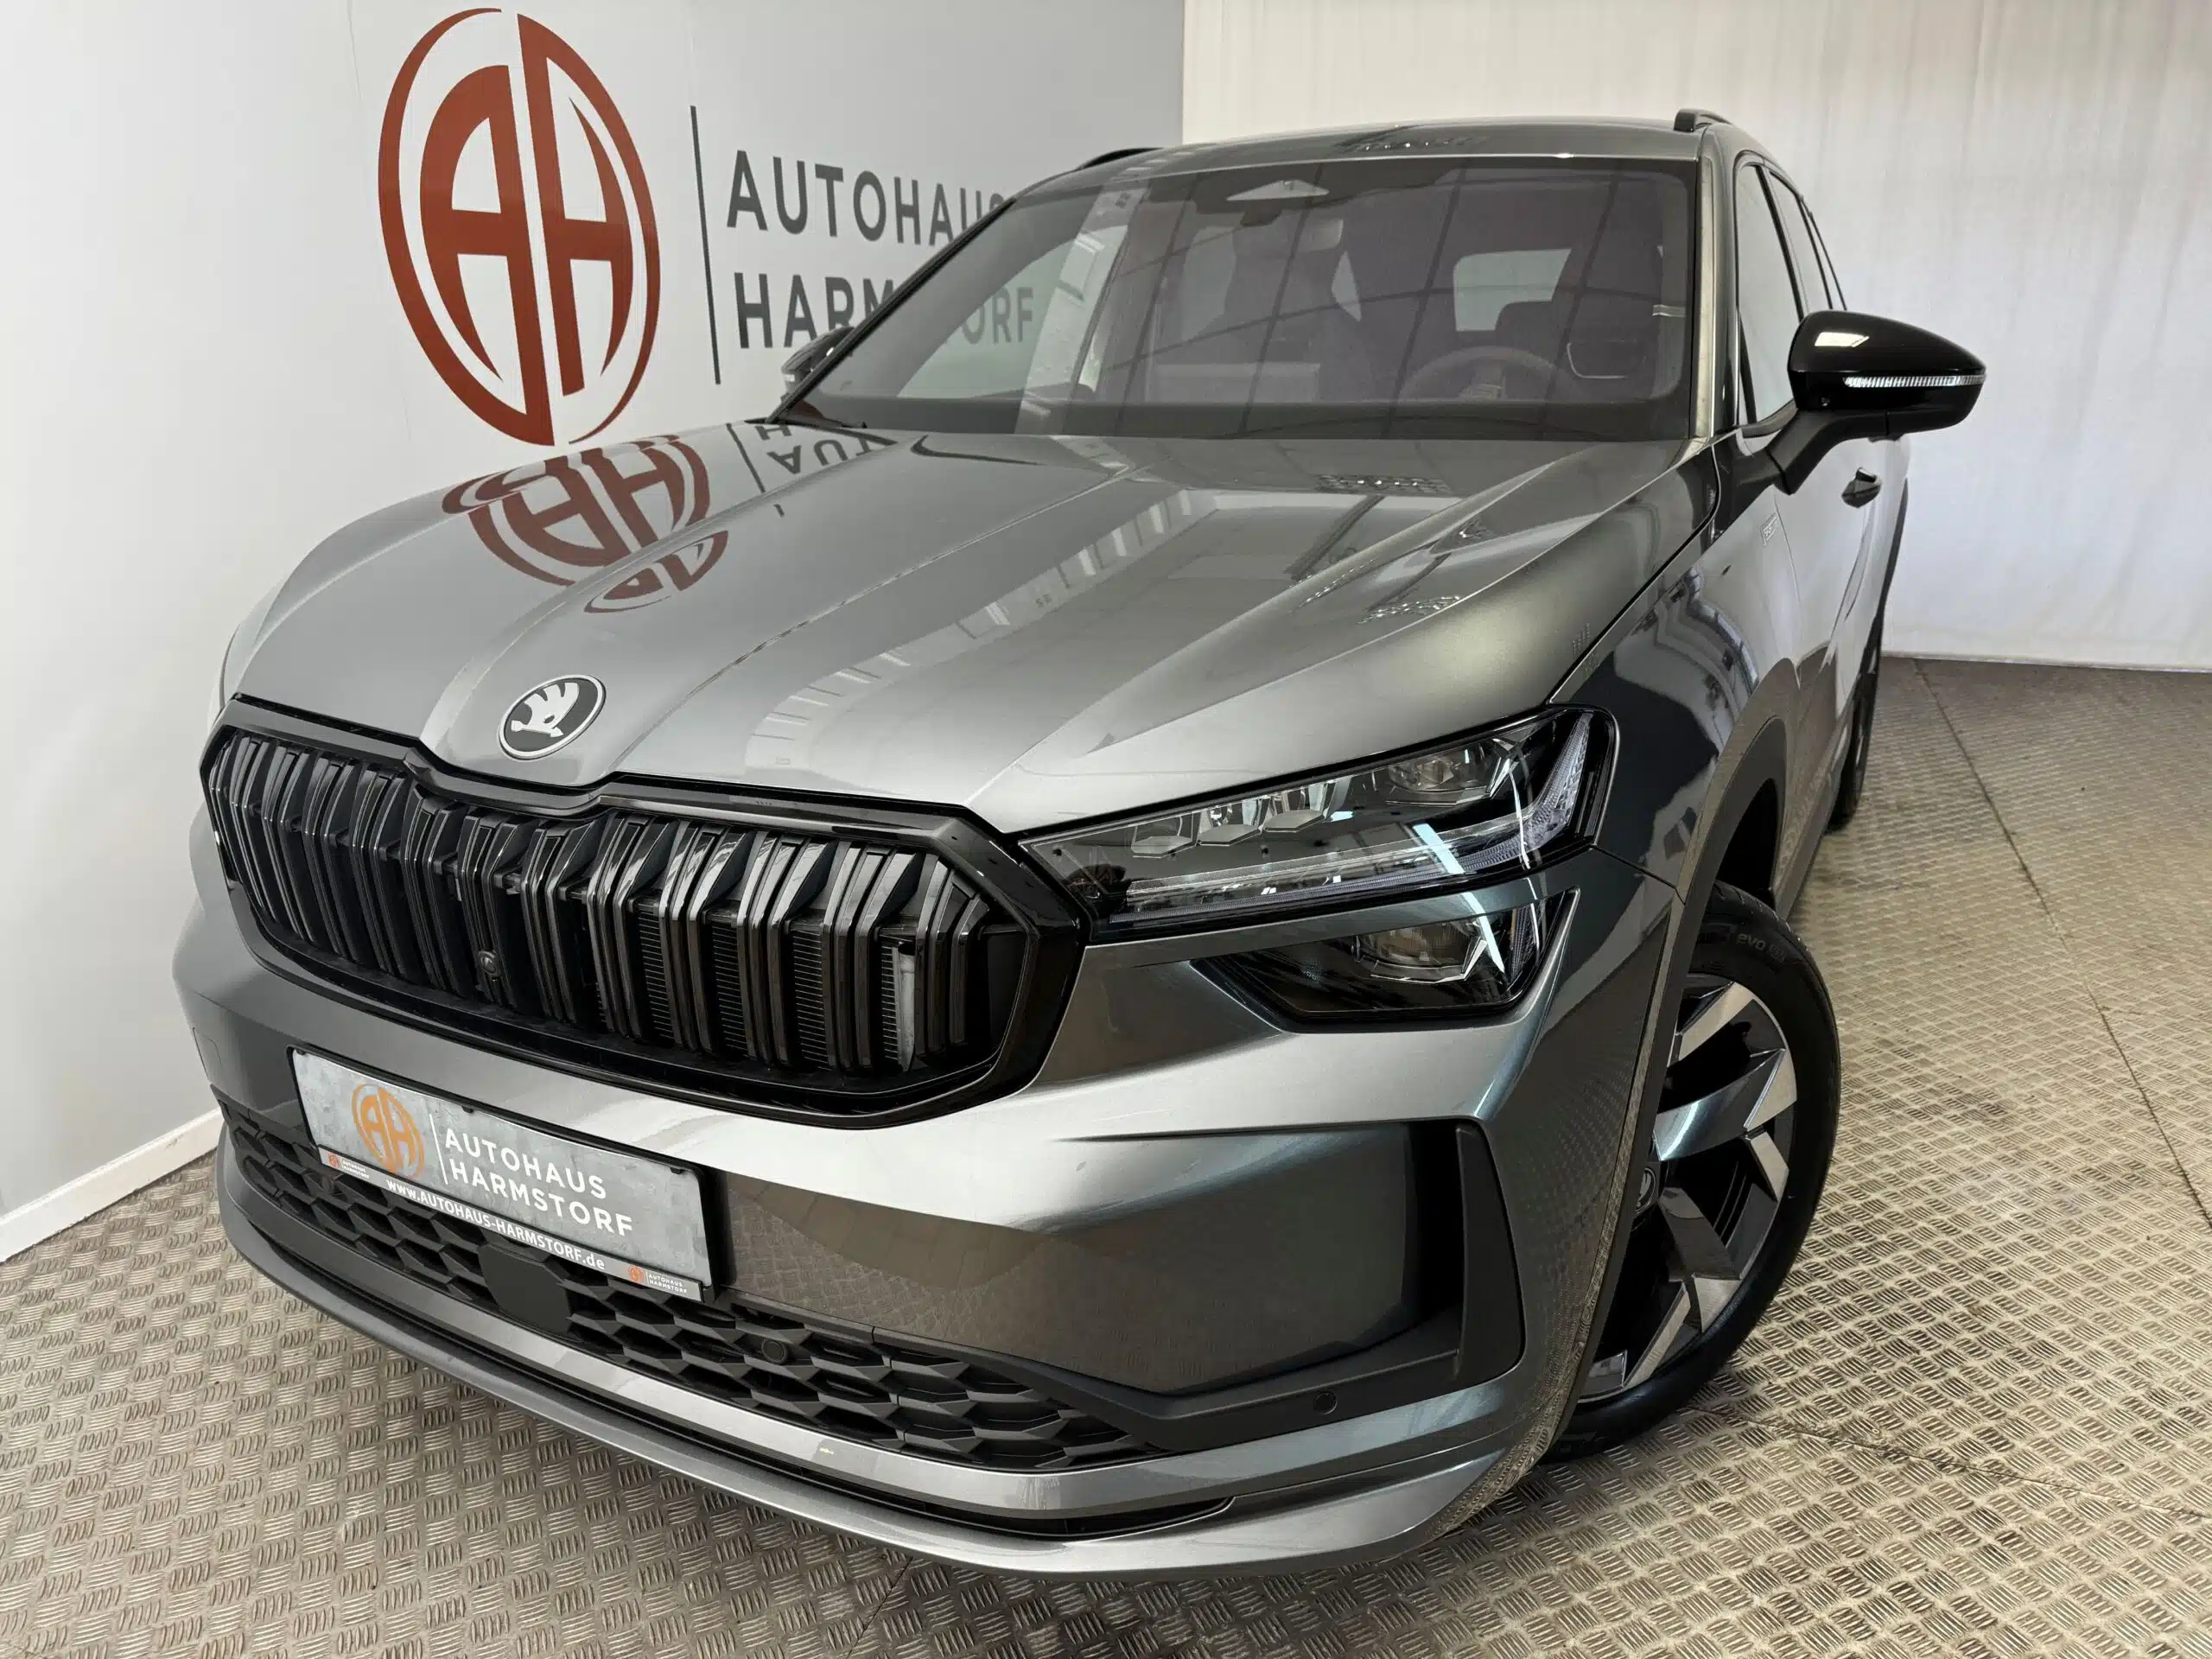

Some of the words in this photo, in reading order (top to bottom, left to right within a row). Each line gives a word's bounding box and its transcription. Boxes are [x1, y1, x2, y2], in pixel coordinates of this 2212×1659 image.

[734, 272, 1034, 349] HARORF
[445, 1128, 607, 1199] AUTOHAUS
[449, 1159, 632, 1236] HARMSTORF
[386, 1179, 606, 1270] www.AUTOHAUS-HARMSTORF.de
[648, 1273, 683, 1287] AUTOHAUS
[649, 1279, 688, 1294] HARMSTORF
